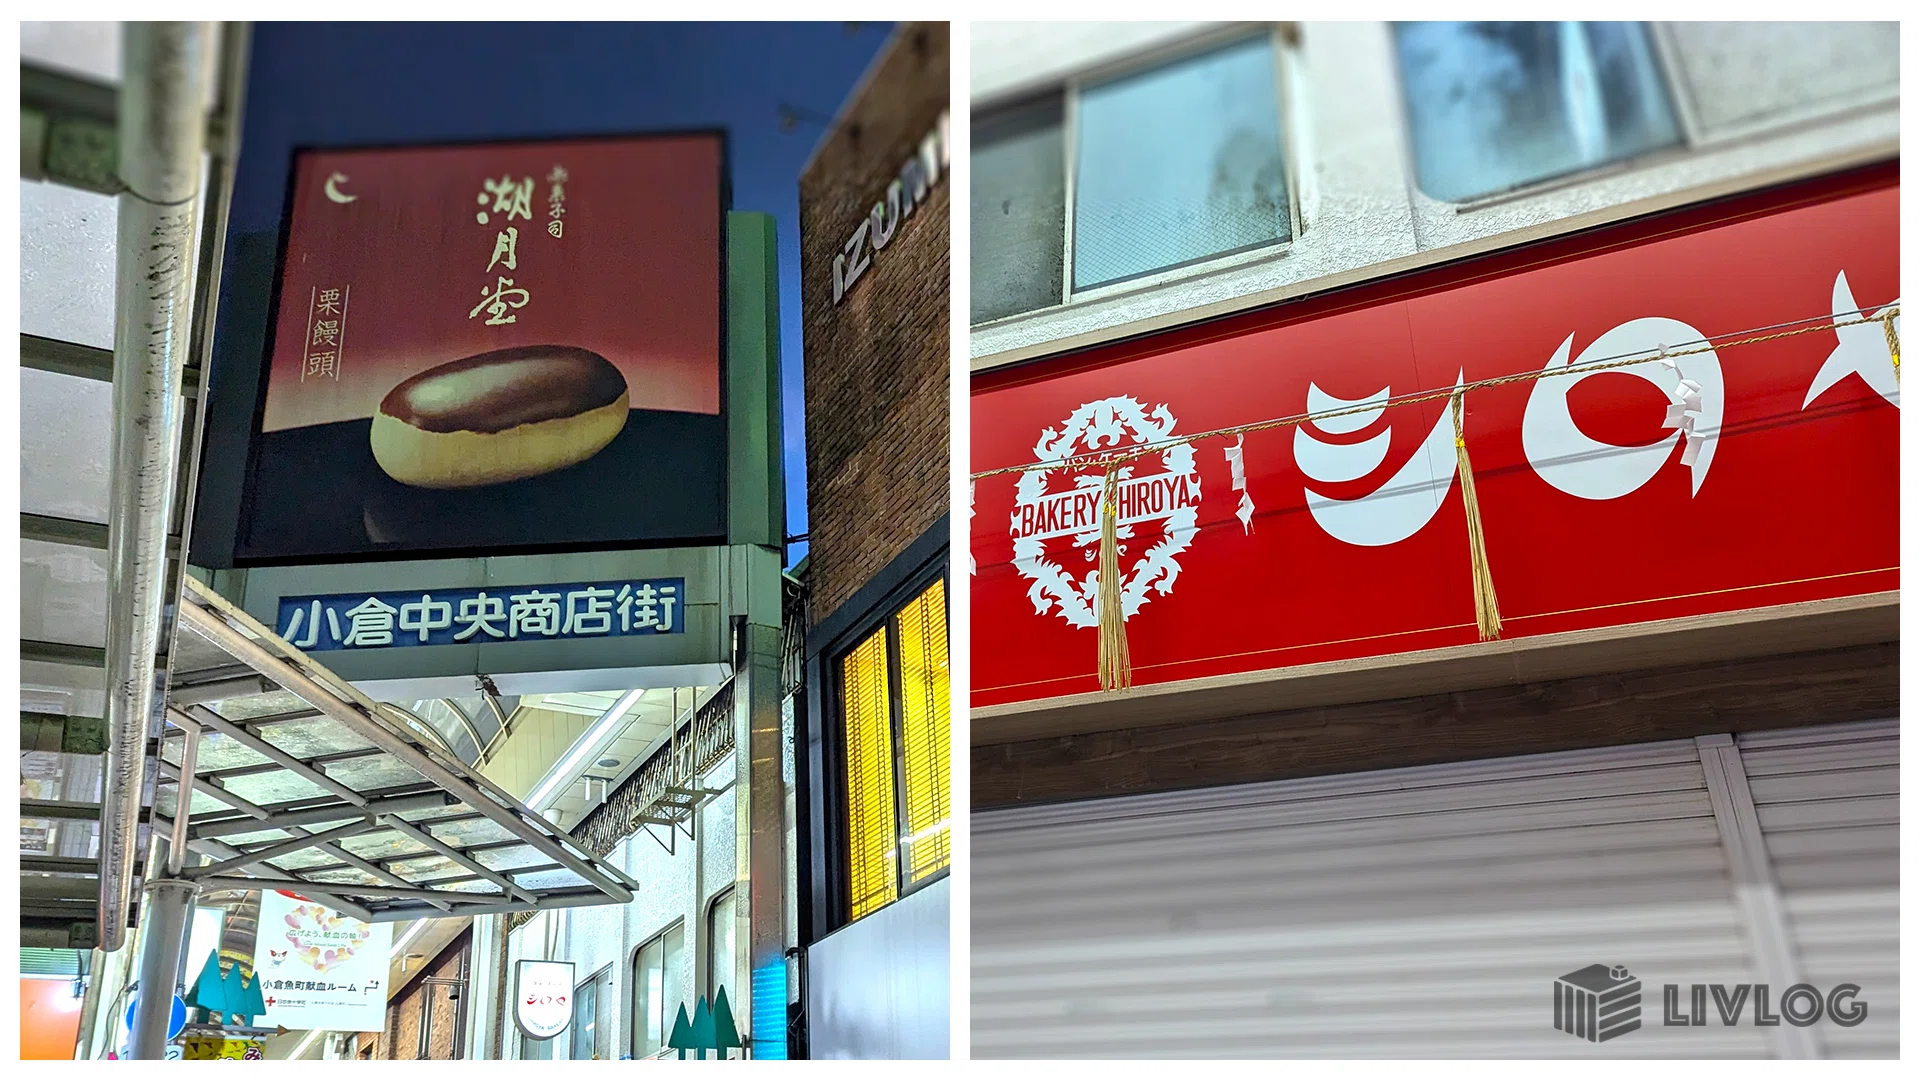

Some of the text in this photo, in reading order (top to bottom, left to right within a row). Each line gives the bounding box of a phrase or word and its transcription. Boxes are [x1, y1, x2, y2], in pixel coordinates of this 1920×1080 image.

[469, 174, 535, 325] 湖月堂
[307, 288, 342, 378] 栗饅頭
[1021, 474, 1192, 538] BAKERY HIROYA
[283, 583, 676, 648] 小倉中央商店街
[262, 979, 357, 992] 小倉魚町献血ルーム
